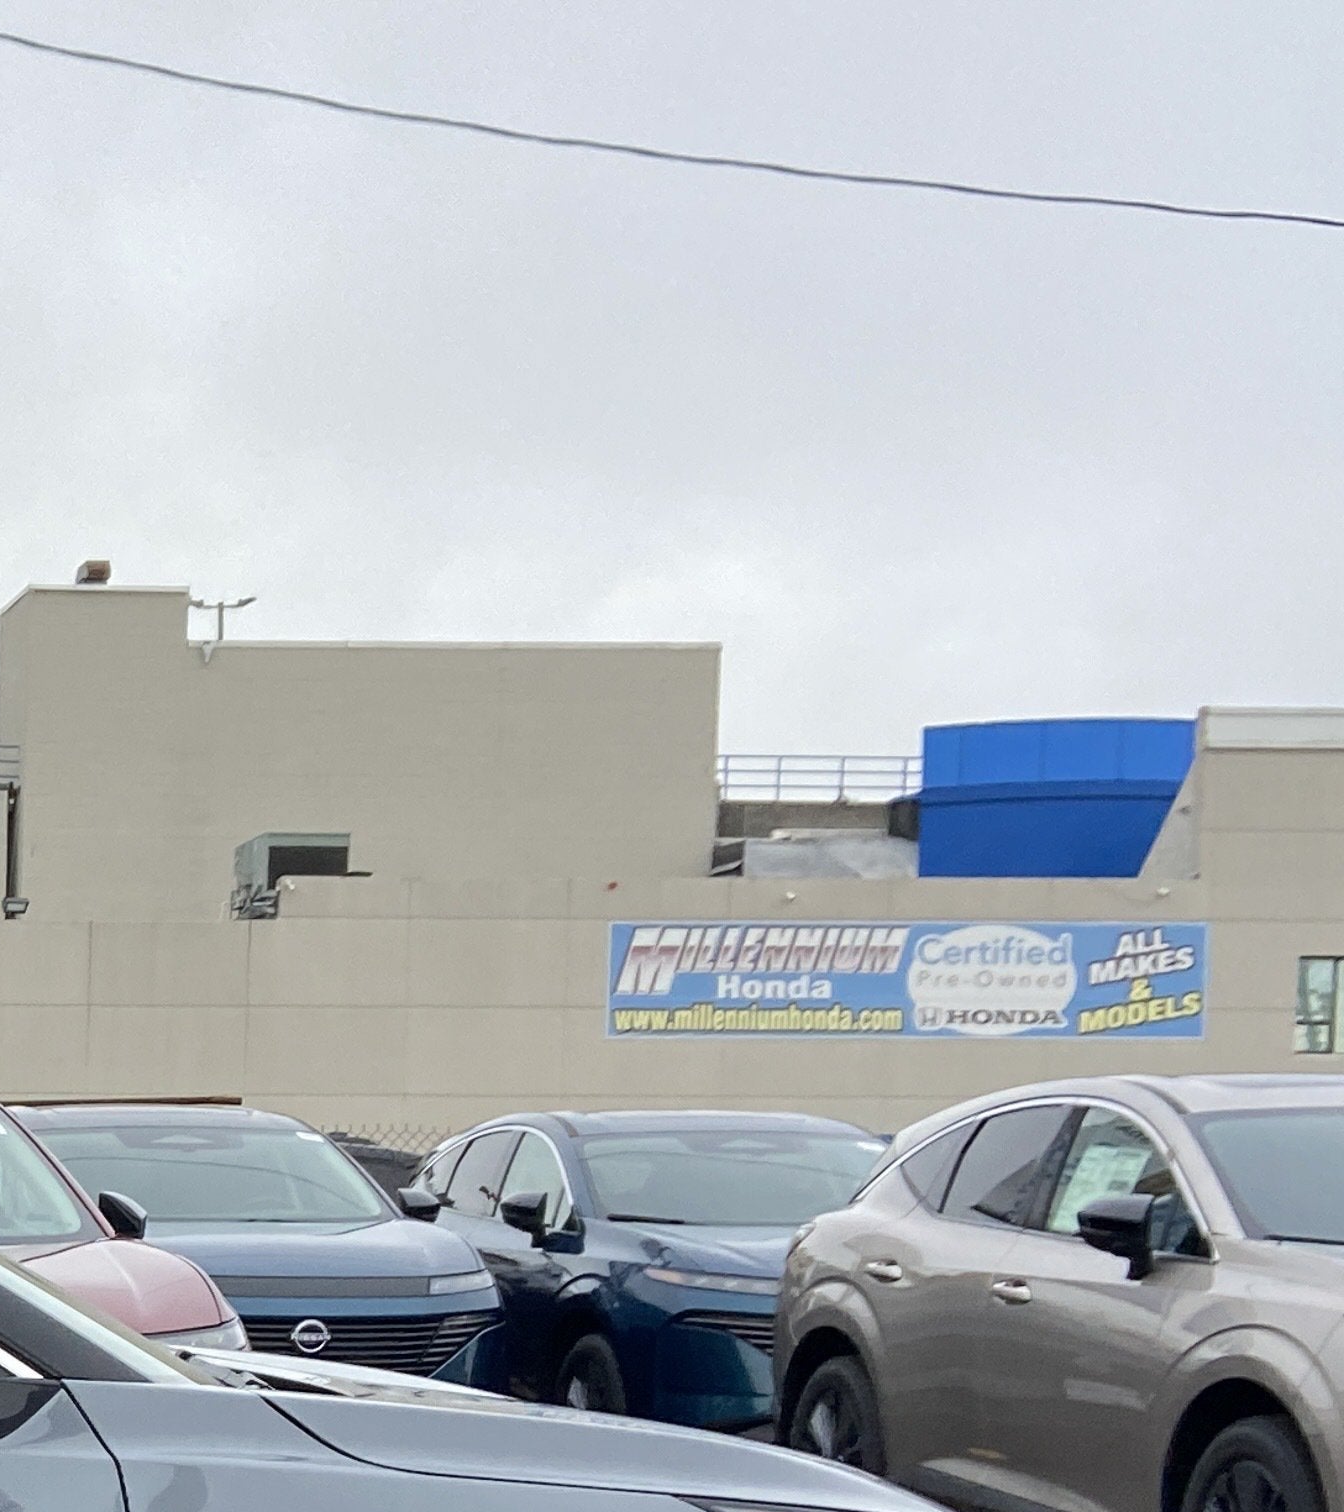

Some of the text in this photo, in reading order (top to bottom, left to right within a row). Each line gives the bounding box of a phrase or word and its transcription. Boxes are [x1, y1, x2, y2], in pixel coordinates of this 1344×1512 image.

[917, 936, 1072, 966] Certified
[1115, 926, 1170, 957] ALL
[612, 926, 911, 996] MILLENNIUM
[1088, 945, 1194, 986] MAKES
[717, 975, 833, 1000] Honda
[915, 970, 1068, 989] Pre-Owned
[1128, 976, 1153, 1001] &
[613, 1003, 904, 1033] www.millenniumhonda.com
[945, 1008, 1064, 1025] HONDA
[1077, 991, 1202, 1035] MODELS
